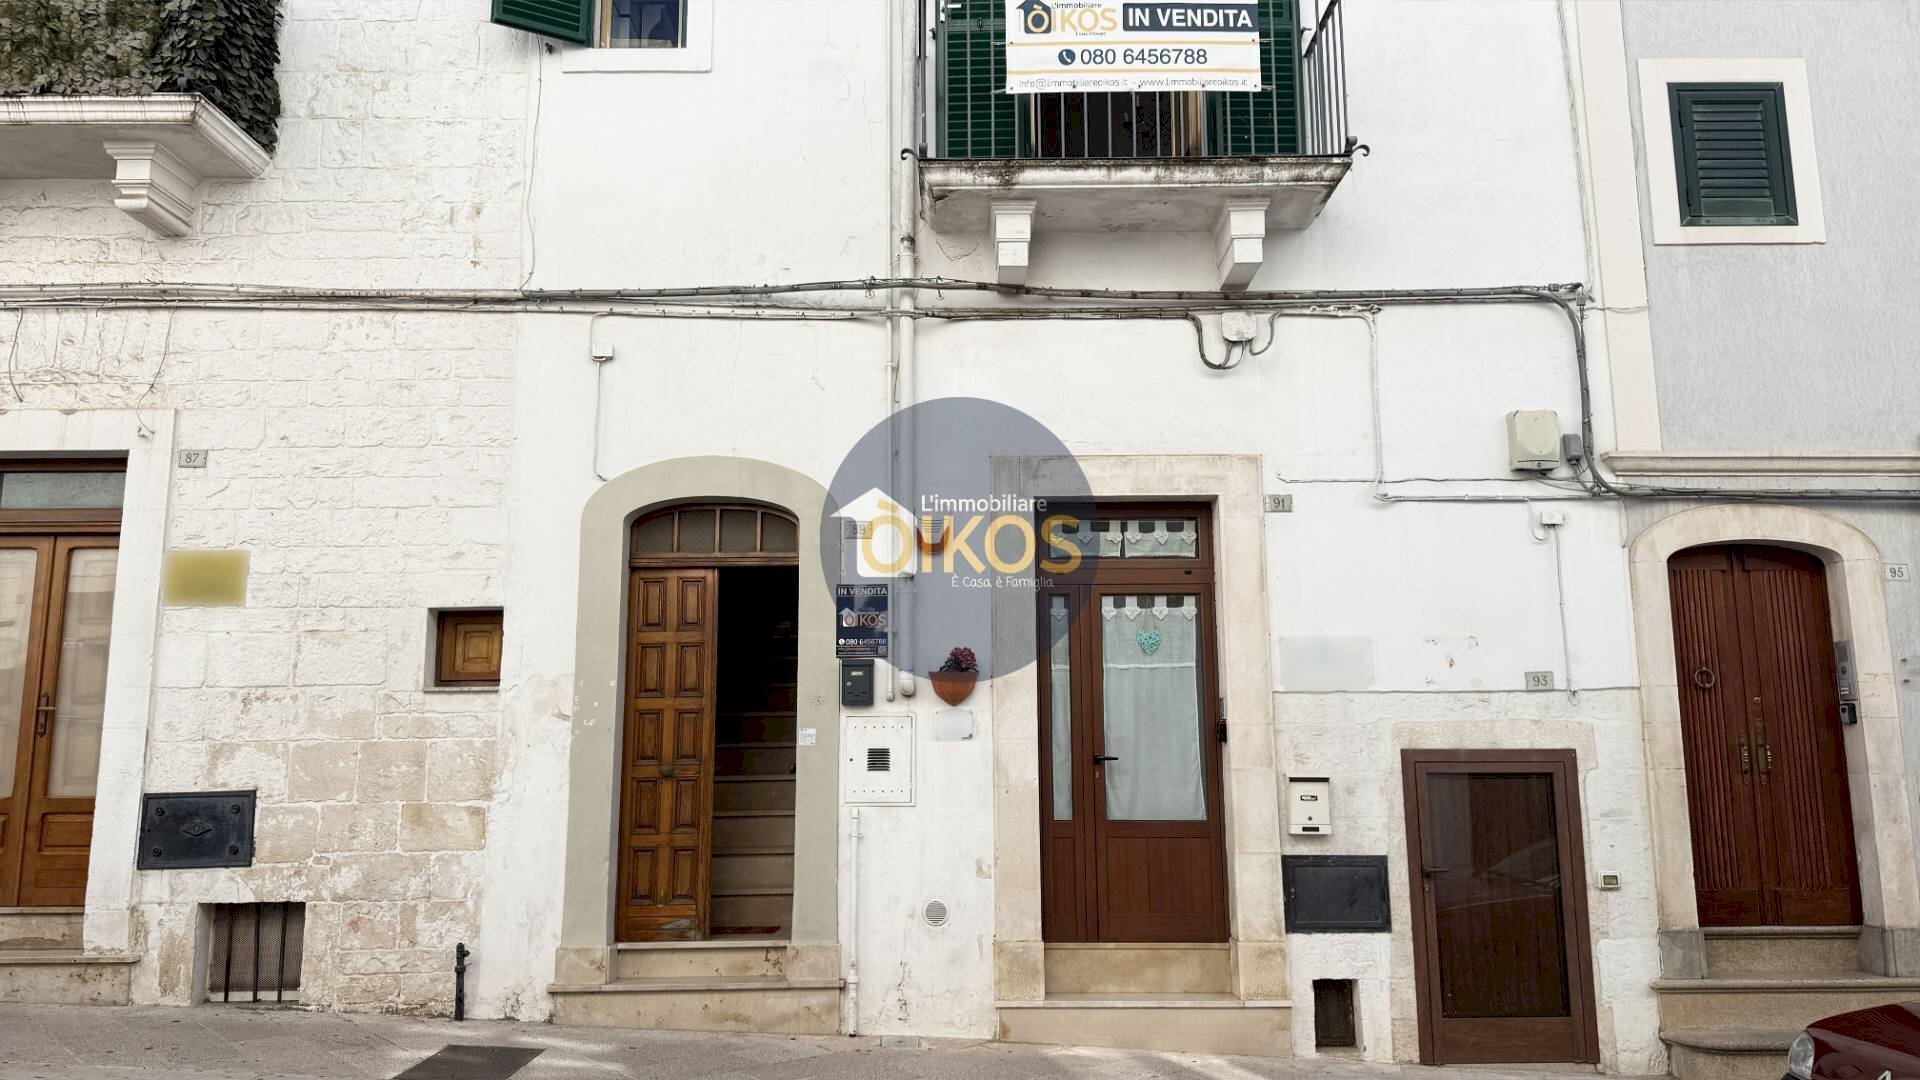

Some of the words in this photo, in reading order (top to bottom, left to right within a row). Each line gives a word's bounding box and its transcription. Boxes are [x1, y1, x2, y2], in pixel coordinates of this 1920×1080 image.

[1128, 8, 1150, 27] IN
[1157, 8, 1253, 28] VENDITA
[1080, 49, 1116, 65] 080
[1123, 49, 1208, 65] 6456788
[185, 452, 200, 463] 87
[1273, 497, 1285, 509] 91
[1889, 566, 1904, 578] 95
[838, 587, 848, 595] IN
[849, 587, 888, 595] VENDITA
[845, 638, 858, 646] 080
[1532, 674, 1548, 687] 93
